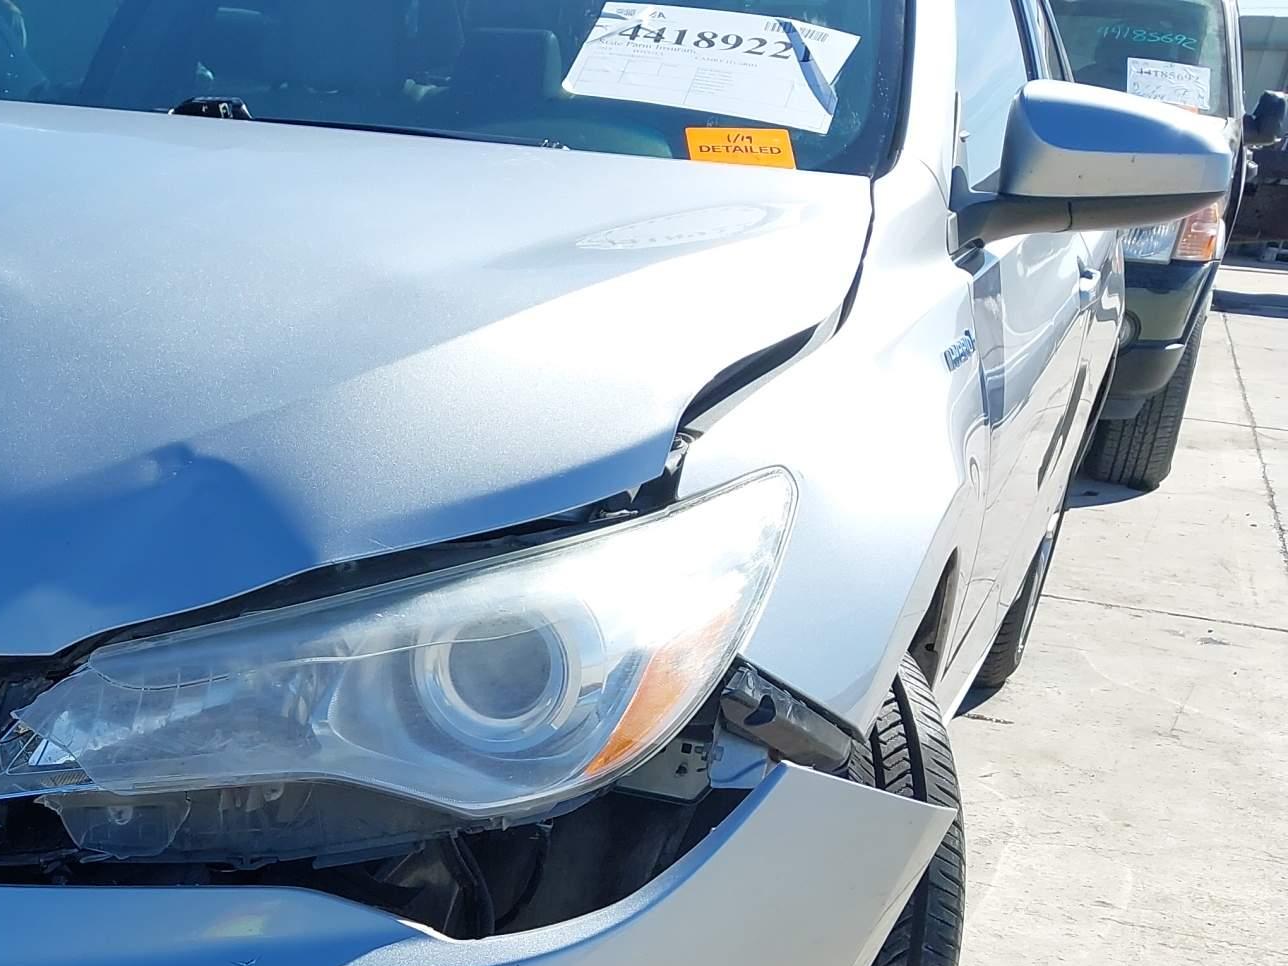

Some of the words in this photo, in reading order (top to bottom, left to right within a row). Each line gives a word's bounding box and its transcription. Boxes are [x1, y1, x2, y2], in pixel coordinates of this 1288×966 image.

[1096, 26, 1198, 50] 44185692
[727, 133, 753, 144] 1/19
[699, 145, 782, 155] DETAILED
